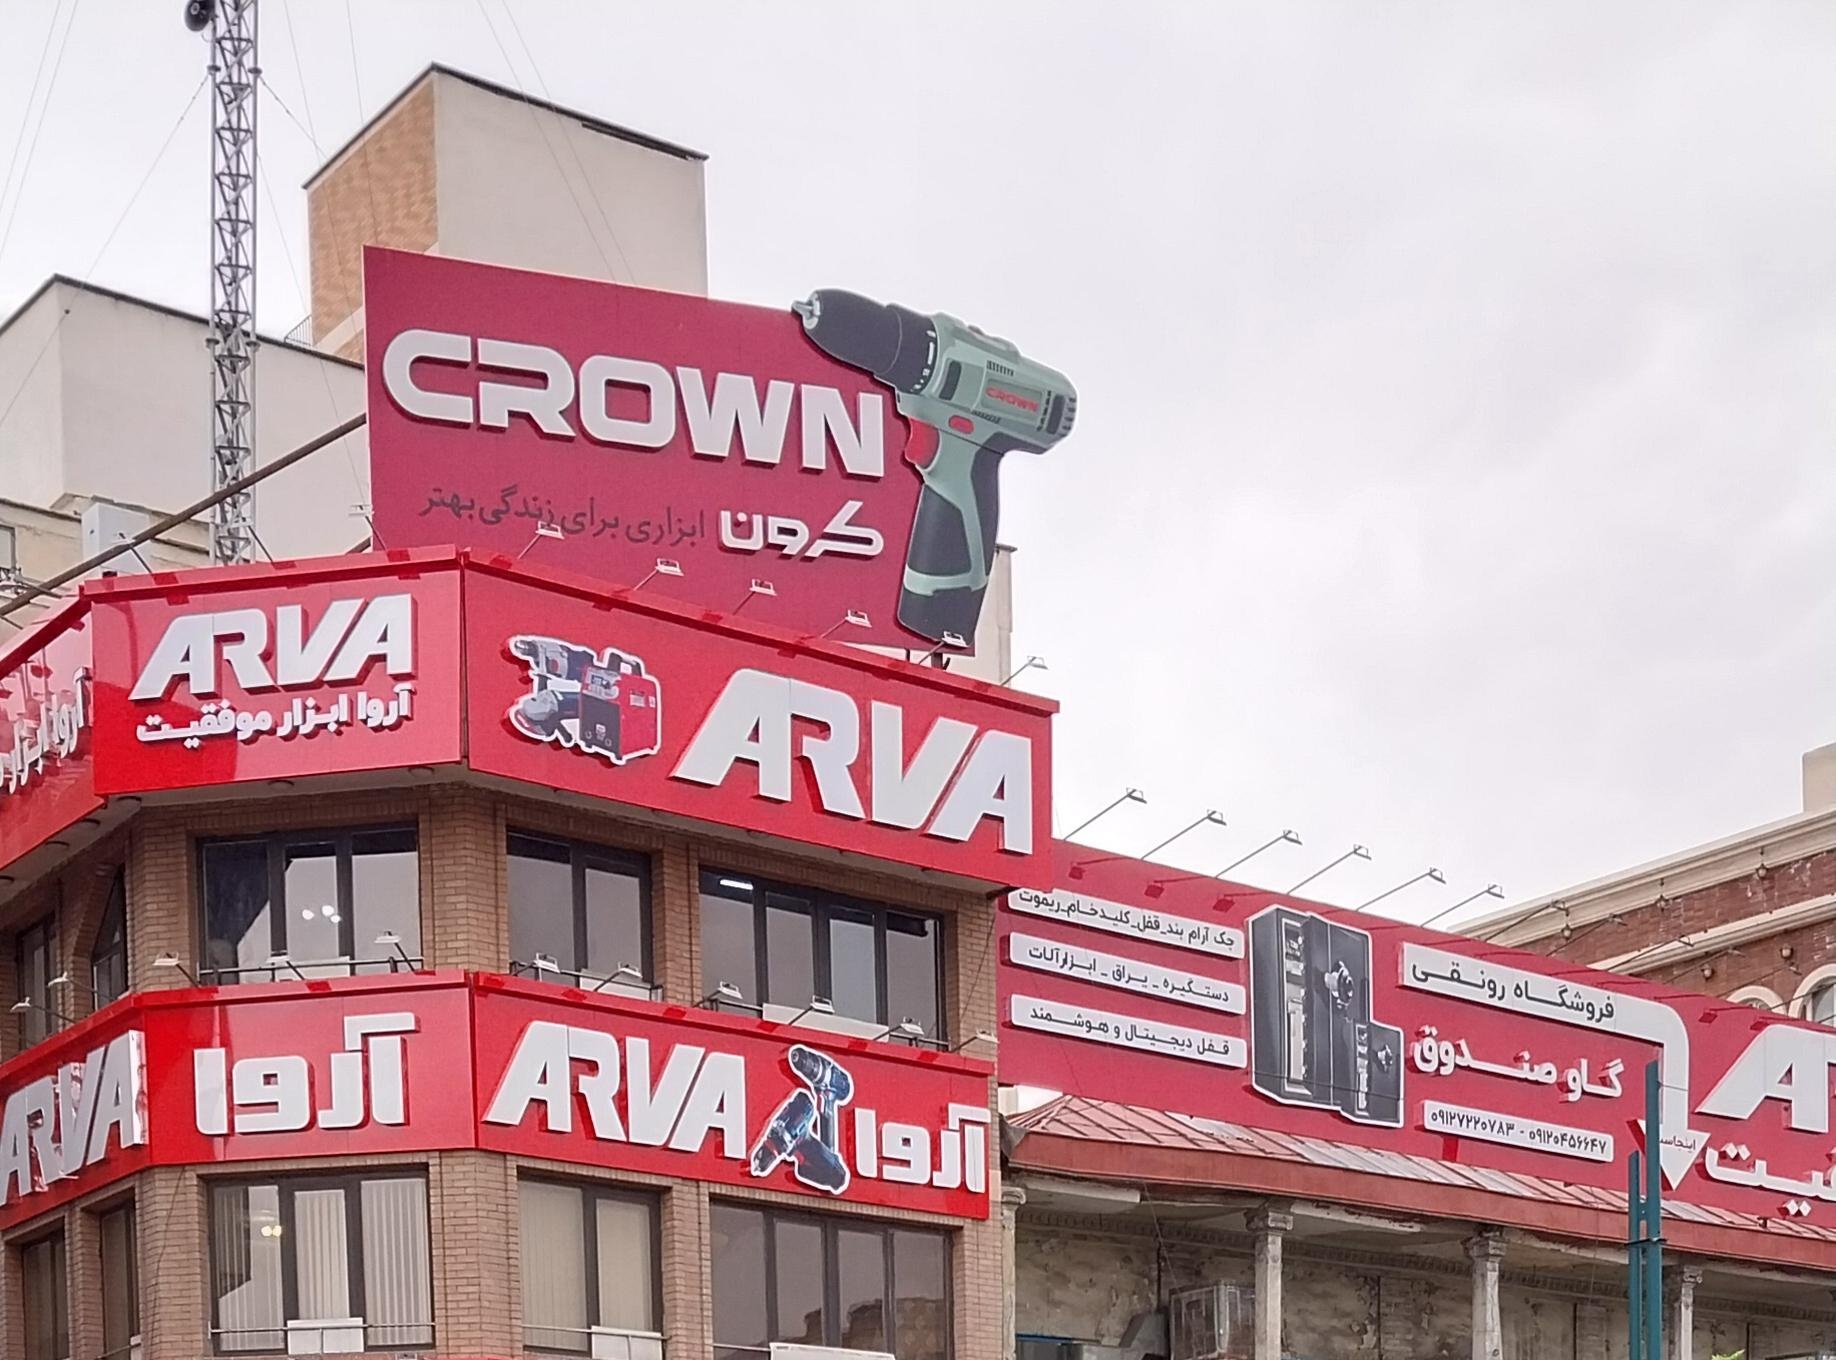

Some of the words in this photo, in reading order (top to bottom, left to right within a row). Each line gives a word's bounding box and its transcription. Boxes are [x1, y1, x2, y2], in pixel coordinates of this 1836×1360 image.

[382, 329, 884, 477] CROWN
[419, 487, 475, 519] بهتر
[479, 485, 555, 531] زندگی
[561, 497, 619, 538] برای
[626, 507, 704, 547] ابزاری
[720, 501, 884, 559] کرون
[128, 594, 414, 701] ARVA
[136, 699, 272, 749] موفقیت
[277, 694, 349, 736] ابزار
[357, 682, 412, 727] آروا
[672, 668, 1033, 855] ARVA
[1112, 964, 1148, 988] یراق
[1163, 977, 1229, 1003] دستگیره
[1412, 961, 1505, 1000] رونقی
[1030, 1007, 1109, 1034] هوشمند
[1514, 980, 1615, 1022] فروشگاه
[1114, 1025, 1120, 1039] و
[1124, 1024, 1193, 1051] دیجیتال
[1197, 1037, 1230, 1056] قفل
[193, 1012, 416, 1135] آروا
[481, 1020, 746, 1159] ARVA
[0, 1029, 142, 1203] ARVA
[855, 1102, 990, 1193] آروا
[1660, 1135, 1697, 1153] اینجاس
